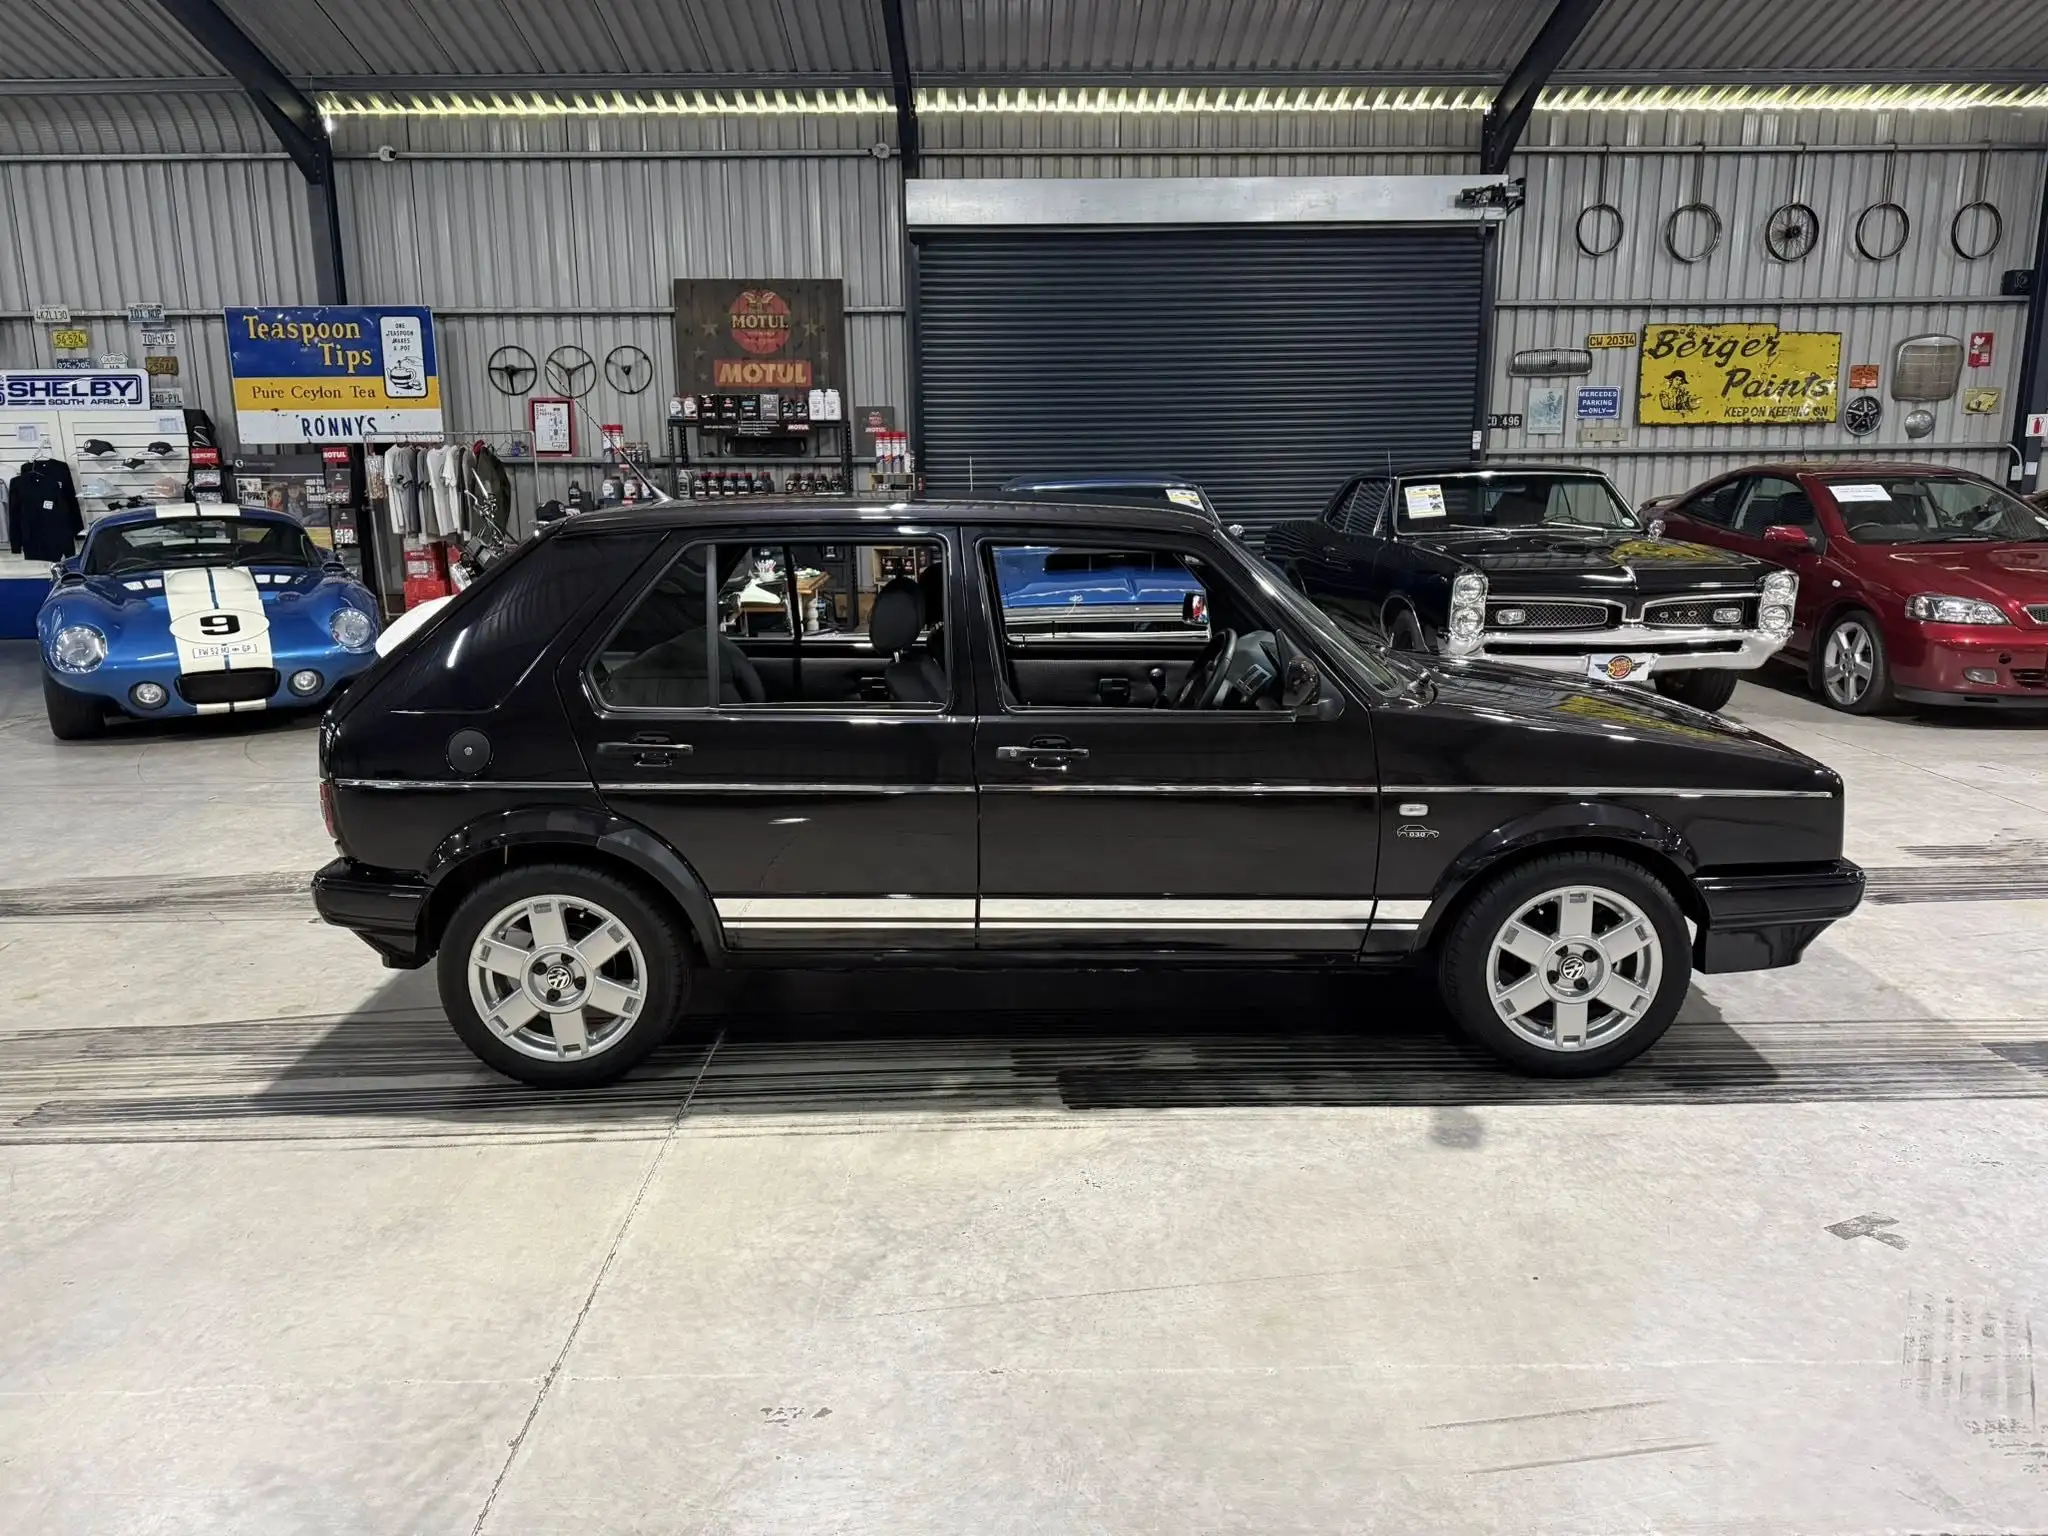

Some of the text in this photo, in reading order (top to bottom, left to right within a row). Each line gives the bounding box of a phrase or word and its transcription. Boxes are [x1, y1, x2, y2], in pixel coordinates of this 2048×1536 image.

[243, 315, 361, 347] Teaspoon
[732, 315, 788, 329] MOTUL
[1589, 335, 1635, 346] CW 20314
[1648, 329, 1780, 368] Berger
[317, 342, 373, 374] Tips
[719, 363, 807, 384] MOTUL
[7, 381, 134, 397] SHELBY
[1721, 367, 1832, 399] Paints
[252, 385, 376, 401] Pure Ceylon Tea
[1724, 405, 1829, 418] KEEP ON KEEPING ON
[1659, 610, 1698, 618] GTO
[200, 614, 241, 636] 9
